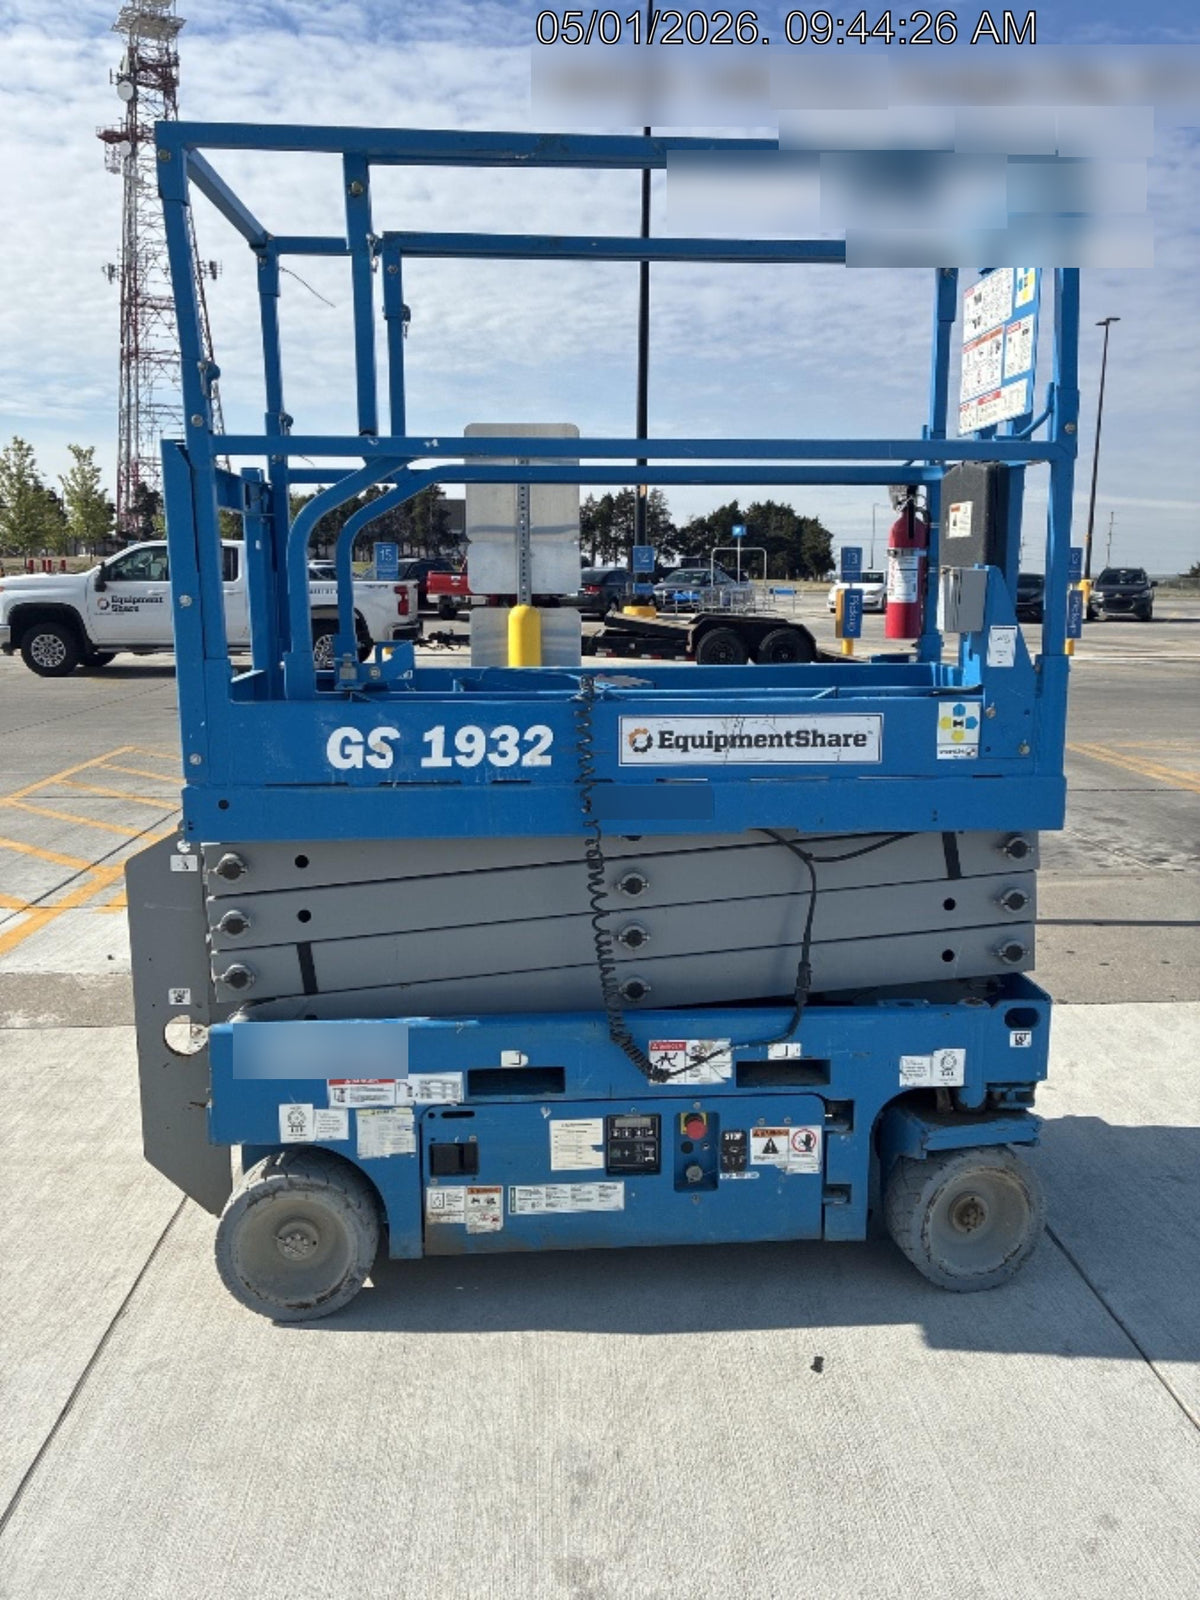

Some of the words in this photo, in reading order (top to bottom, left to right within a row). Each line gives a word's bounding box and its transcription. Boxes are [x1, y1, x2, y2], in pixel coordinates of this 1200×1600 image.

[379, 549, 393, 561] 15
[111, 595, 164, 605] Equipment
[111, 604, 139, 612] Share
[326, 726, 401, 769] GS
[420, 724, 554, 768] 1932
[657, 729, 868, 753] EquipmentShare
